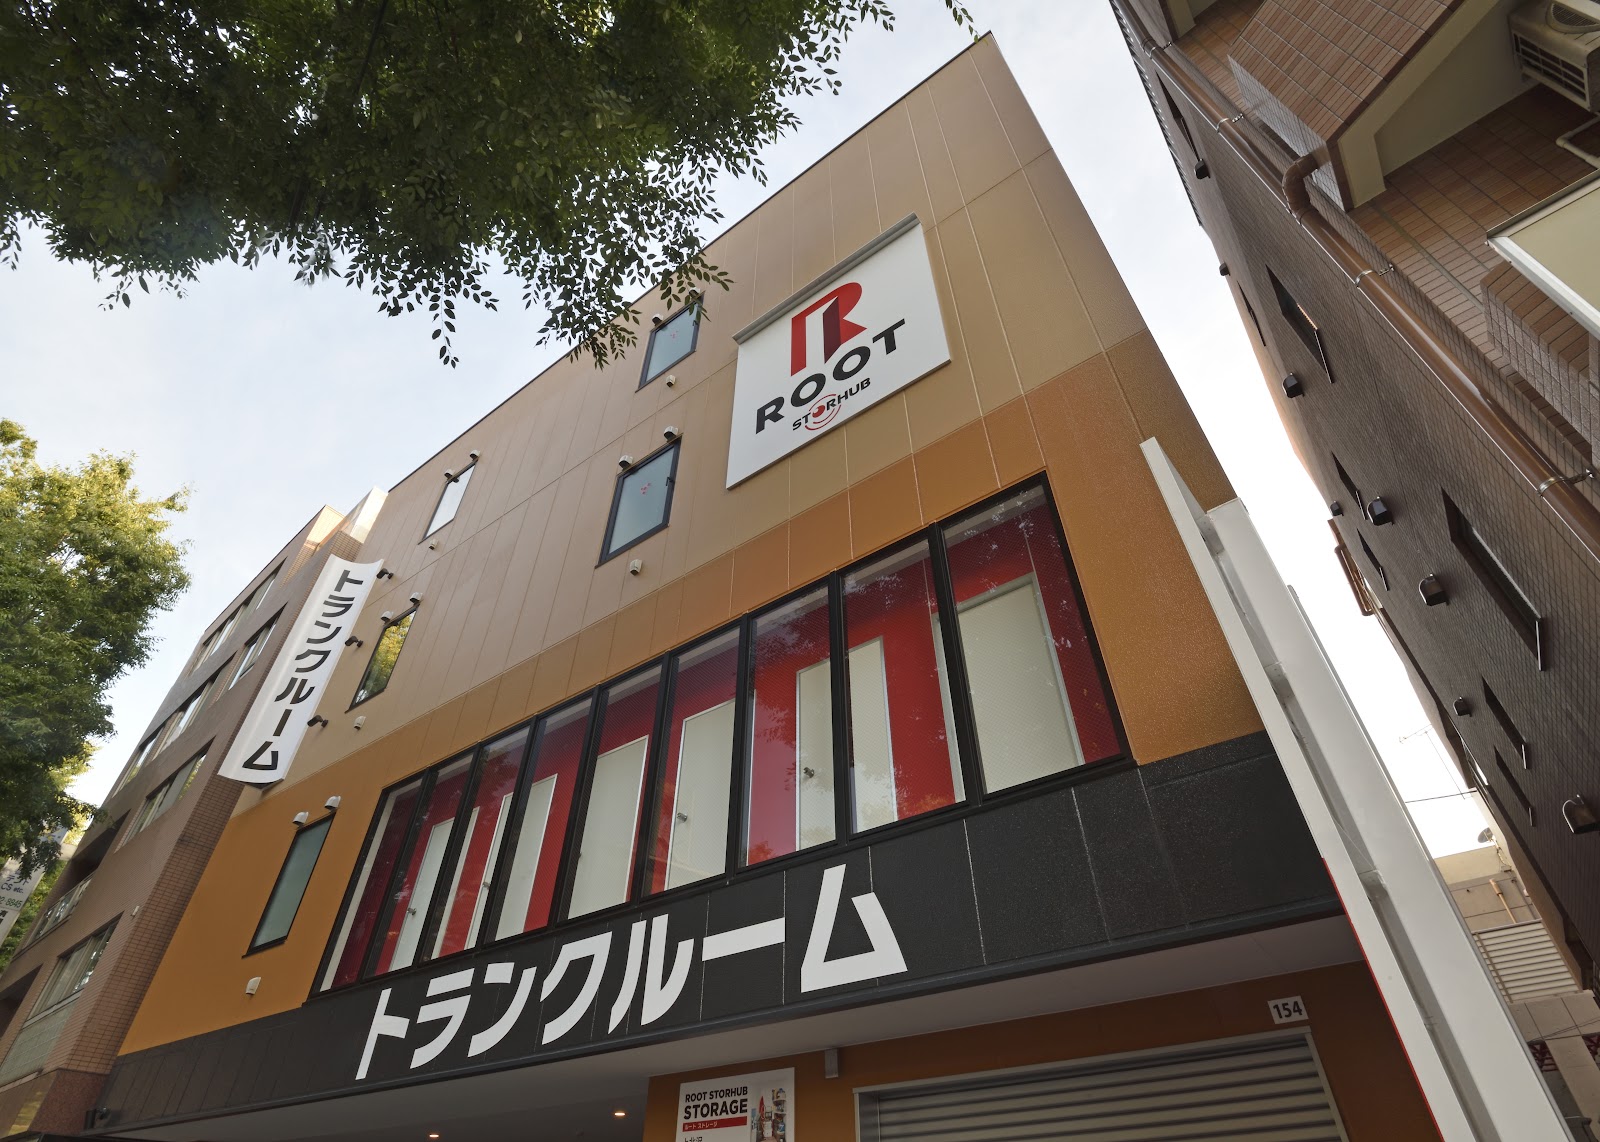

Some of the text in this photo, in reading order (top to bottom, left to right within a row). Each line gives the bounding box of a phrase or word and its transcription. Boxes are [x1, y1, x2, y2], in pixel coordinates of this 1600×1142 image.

[755, 318, 906, 435] ROOT
[792, 377, 871, 431] STORHUB
[242, 569, 364, 771] トランクルーム
[355, 864, 909, 1081] トランクルーム
[1272, 1001, 1303, 1019] 154
[683, 1098, 748, 1120] STORAGE
[685, 1086, 748, 1103] ROOT STORHUB
